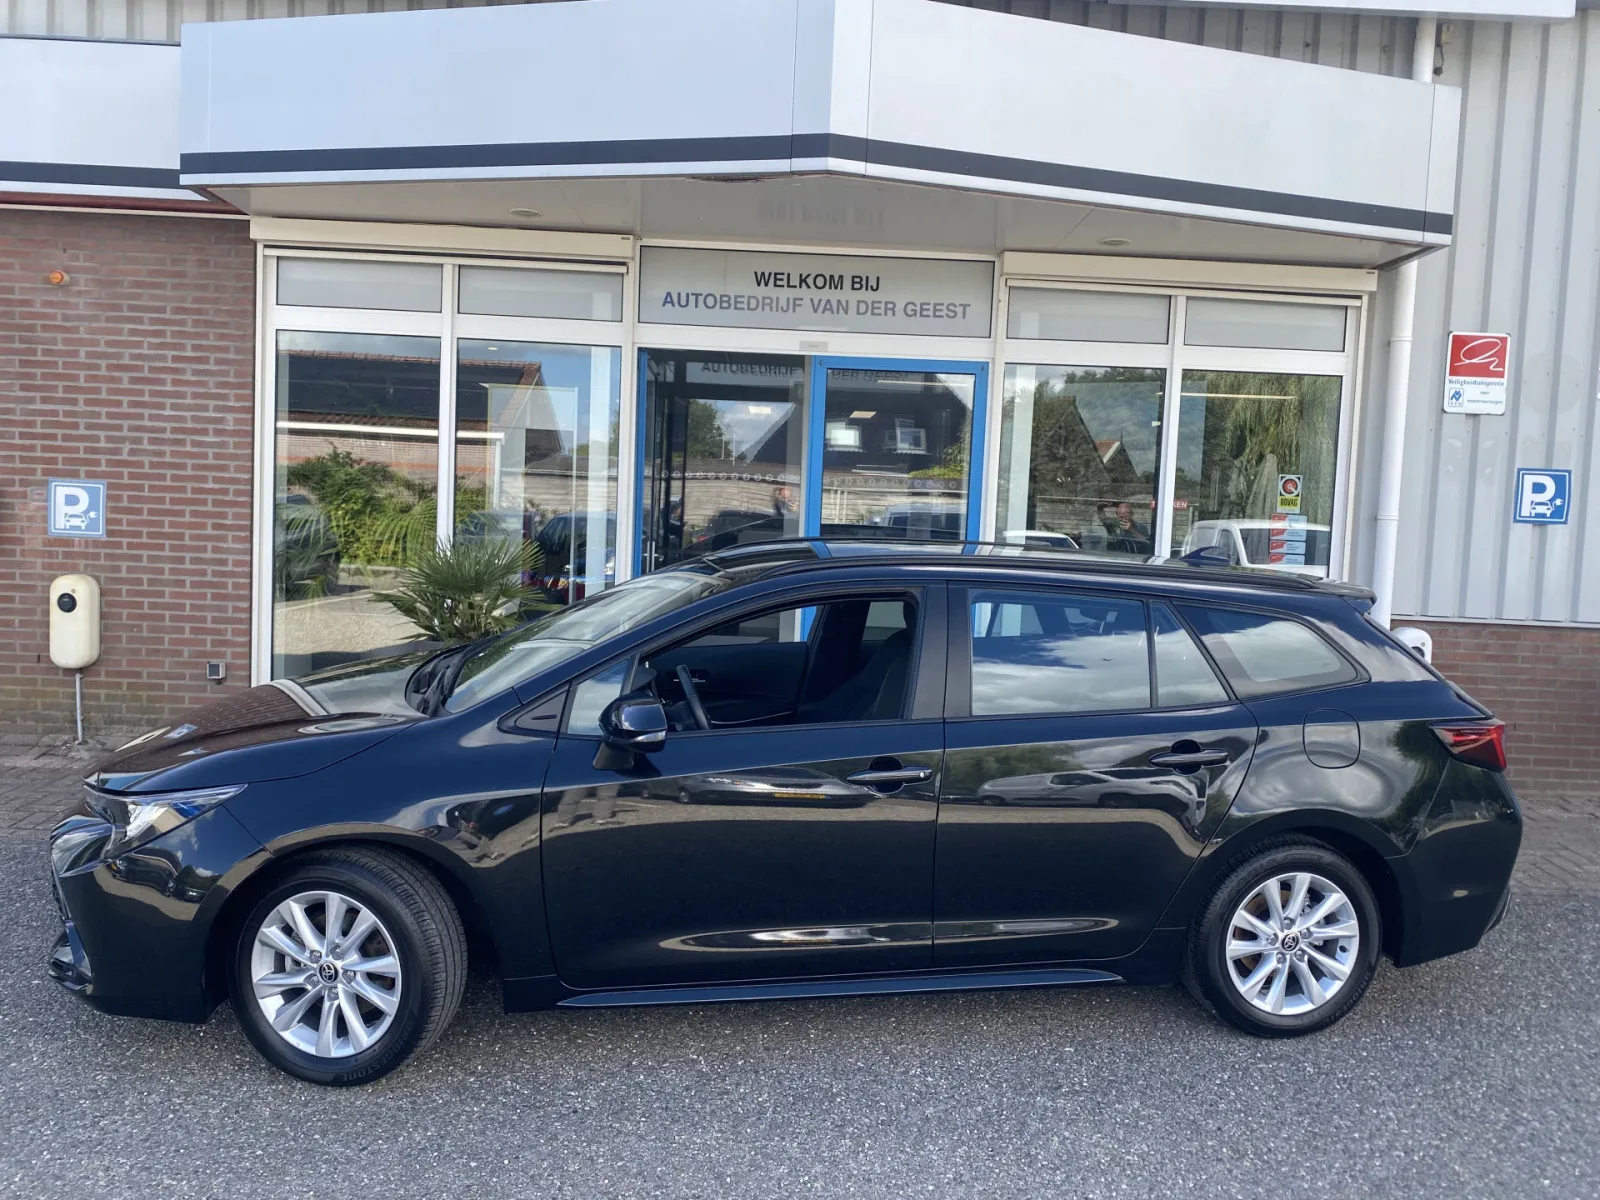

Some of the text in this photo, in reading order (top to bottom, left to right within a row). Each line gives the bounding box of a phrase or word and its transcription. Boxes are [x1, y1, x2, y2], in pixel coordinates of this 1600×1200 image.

[754, 271, 880, 292] WELKOM BIJ
[662, 291, 971, 320] AUTOBEDRIJF VAN DER GEEST
[1520, 474, 1556, 517] P
